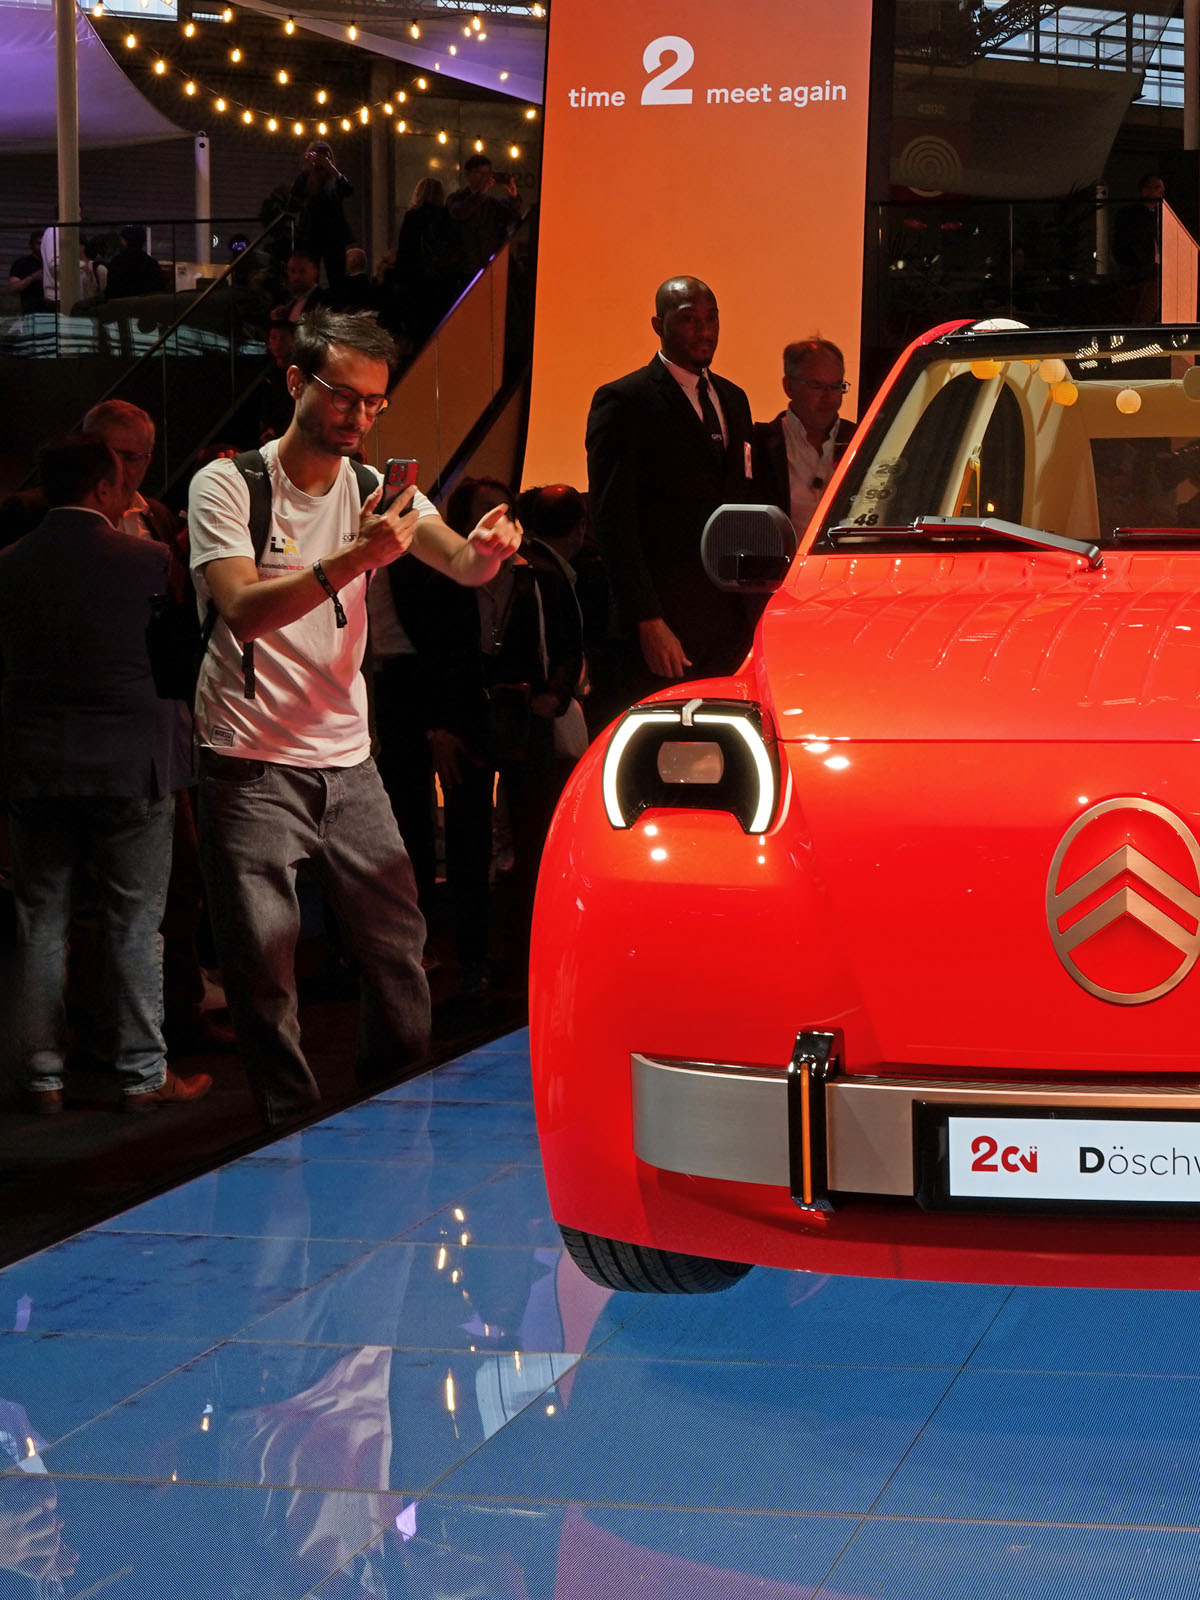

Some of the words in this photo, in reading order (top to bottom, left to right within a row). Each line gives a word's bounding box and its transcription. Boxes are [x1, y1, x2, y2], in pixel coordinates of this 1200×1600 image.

[568, 87, 626, 108] time
[640, 35, 695, 106] 2
[706, 83, 772, 104] meet
[778, 79, 847, 108] again
[853, 513, 880, 526] 48
